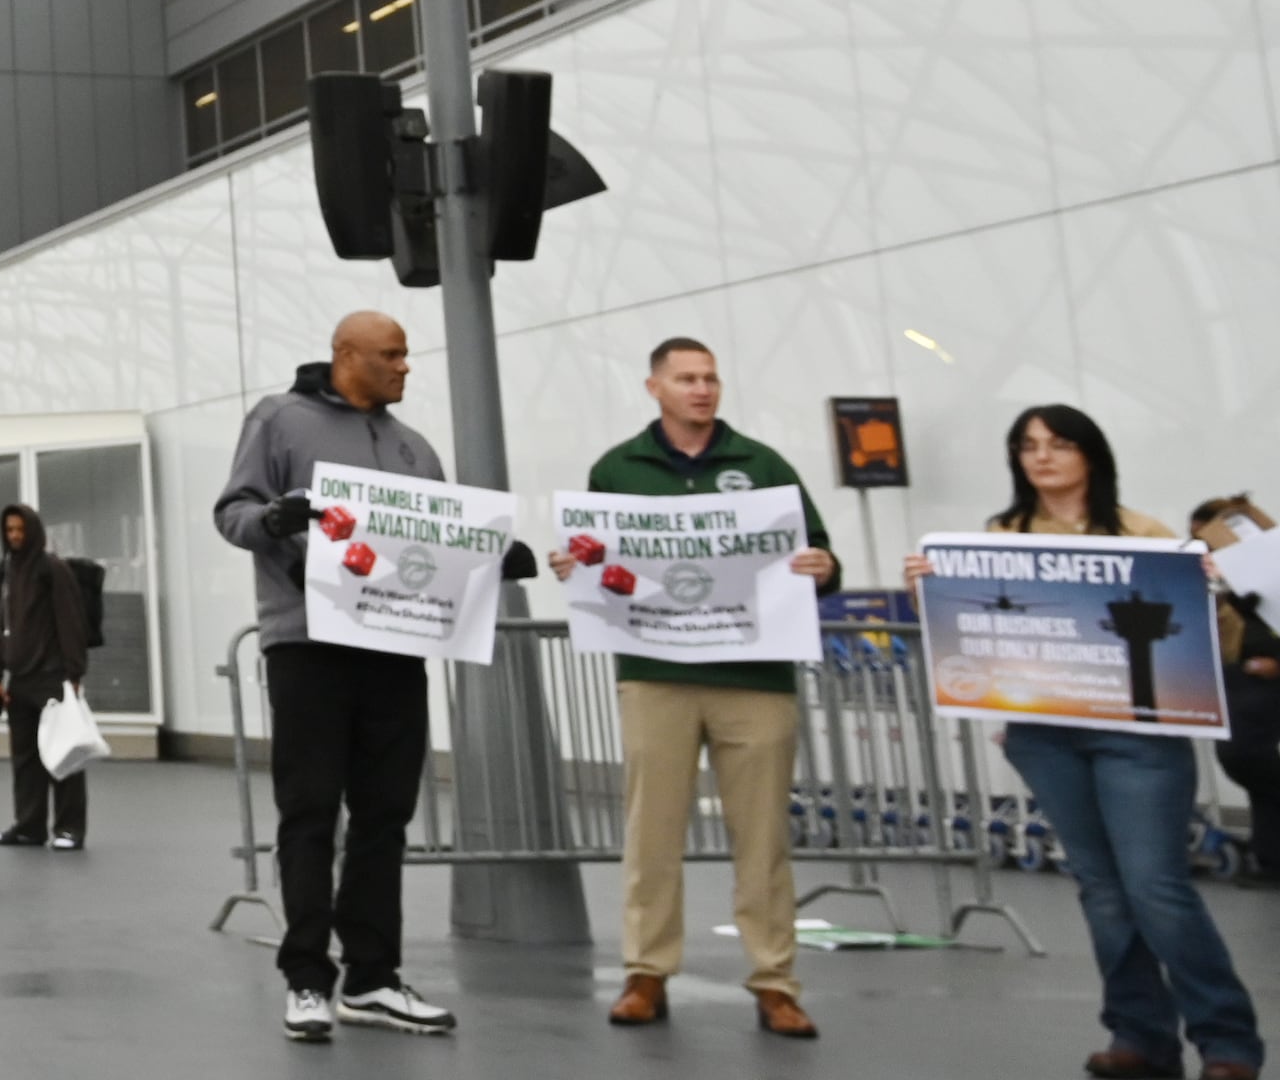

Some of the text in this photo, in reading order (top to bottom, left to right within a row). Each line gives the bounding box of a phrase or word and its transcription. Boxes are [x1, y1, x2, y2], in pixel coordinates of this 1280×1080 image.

[320, 477, 462, 518] DON'T GAMBLE WITH
[366, 511, 507, 555] AVIATION SAFETY
[563, 508, 736, 532] DON'T GAMBLE WITH
[619, 529, 798, 560] AVIATION SAFETY
[926, 549, 1134, 584] AVIATION SAFETY
